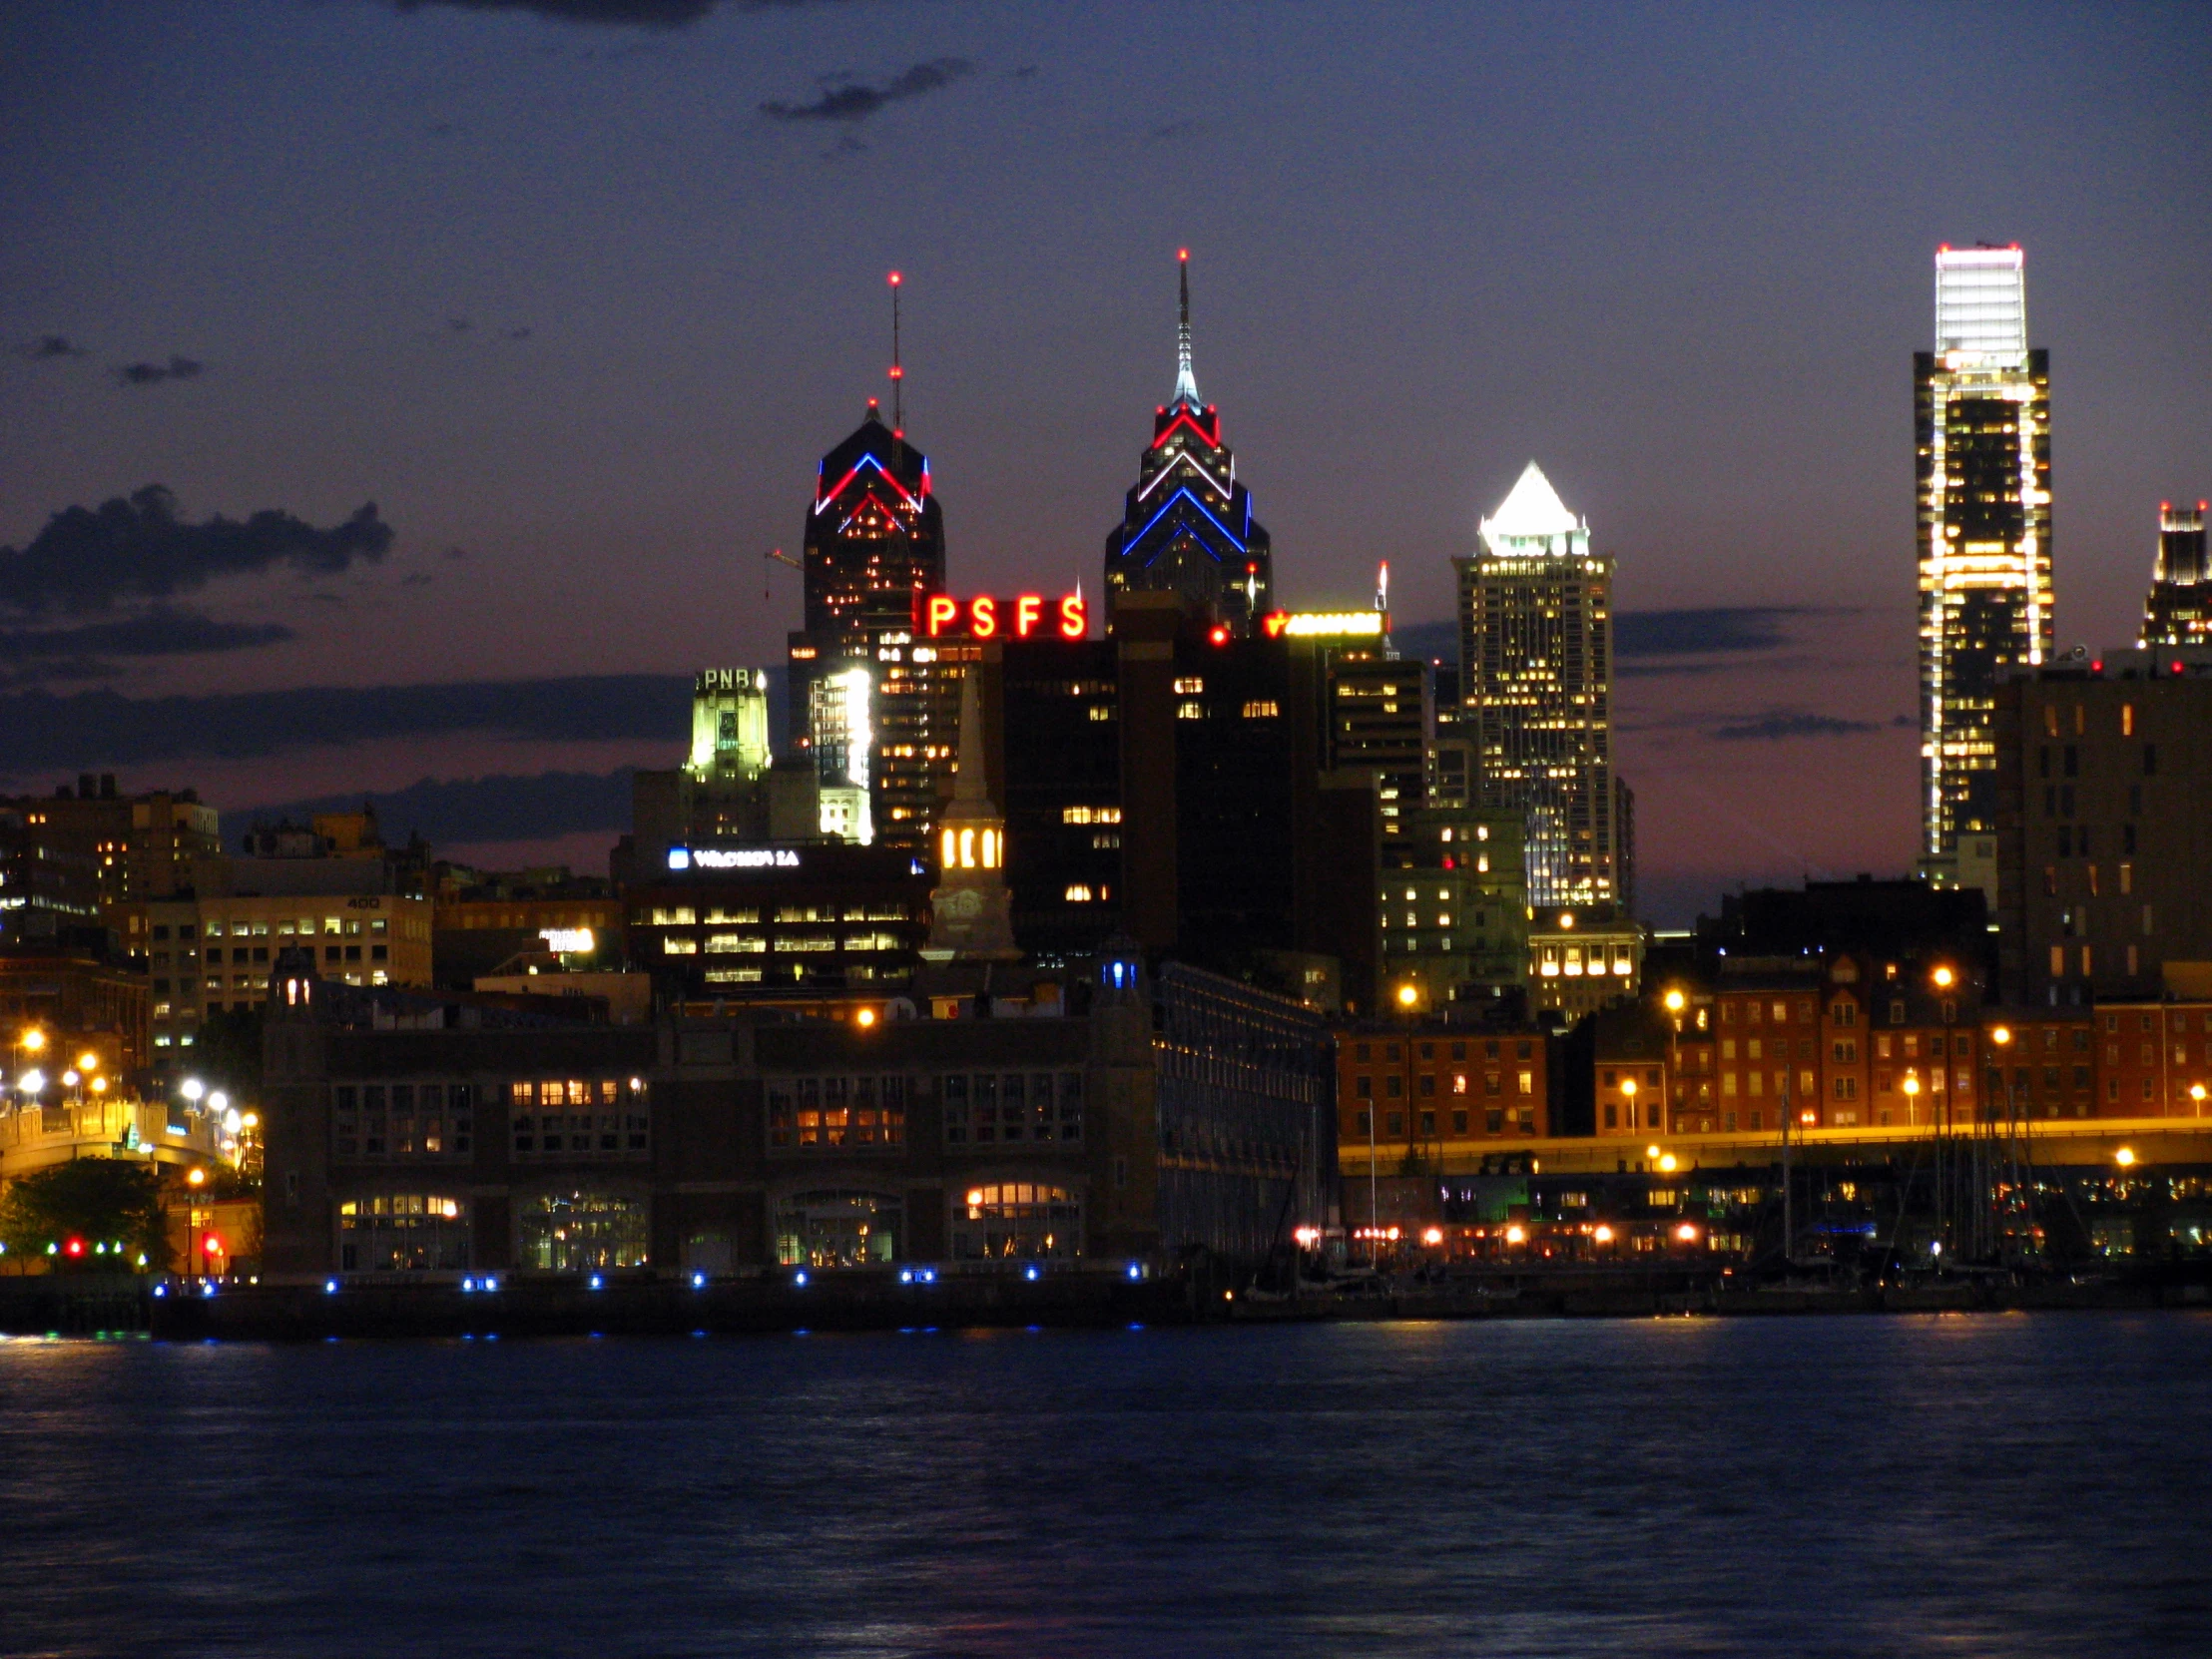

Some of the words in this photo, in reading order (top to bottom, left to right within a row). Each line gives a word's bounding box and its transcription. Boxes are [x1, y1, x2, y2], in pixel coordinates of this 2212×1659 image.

[929, 596, 1085, 638] PSFS
[705, 668, 750, 690] PNB
[347, 898, 380, 908] 400
